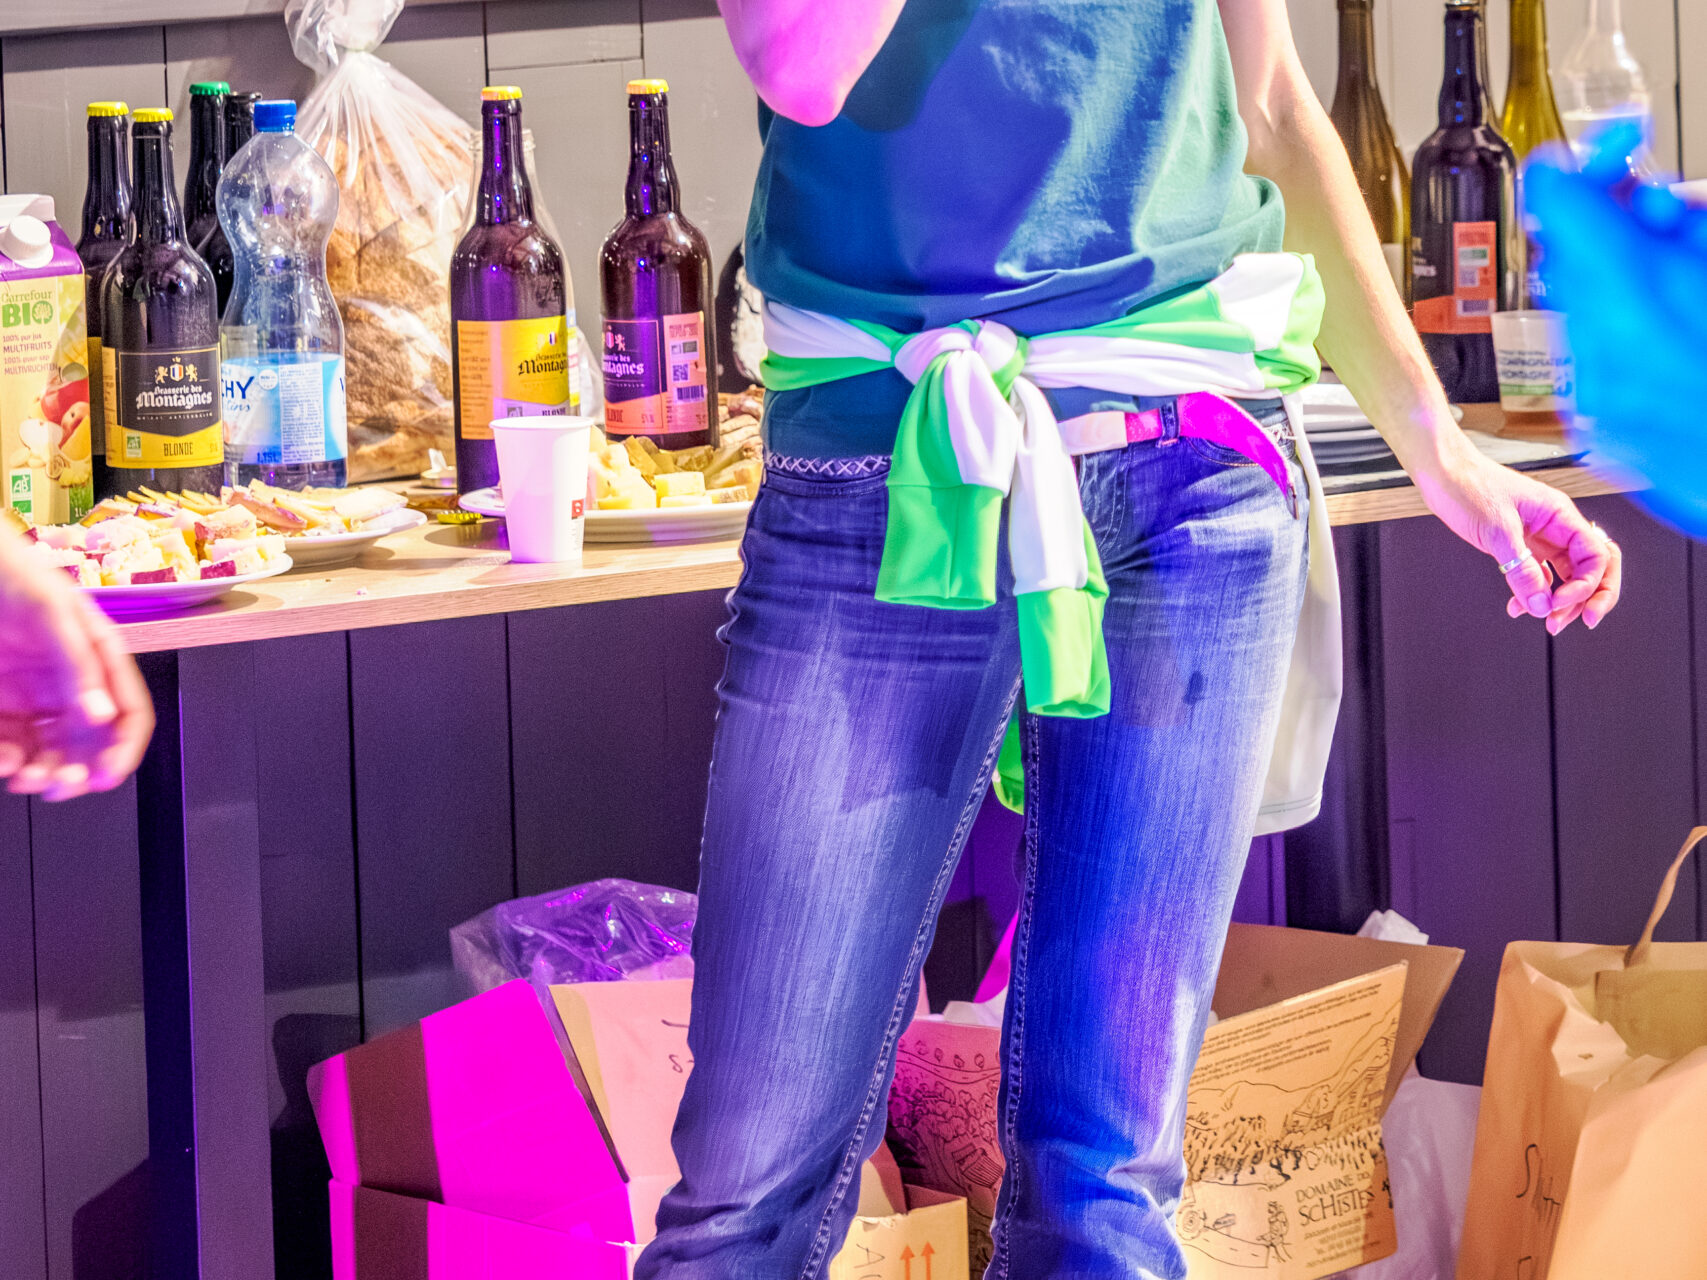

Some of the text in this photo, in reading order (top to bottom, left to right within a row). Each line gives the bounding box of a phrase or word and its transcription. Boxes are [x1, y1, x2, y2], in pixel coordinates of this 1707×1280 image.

[2, 289, 52, 303] Carrefour
[2, 300, 53, 328] BIO
[3, 341, 52, 354] MULTIFRUITS
[154, 384, 202, 395] Brasserie des
[135, 391, 213, 410] Montagnes
[163, 442, 194, 457] BLONDE
[1295, 1174, 1355, 1204] DOMAINE
